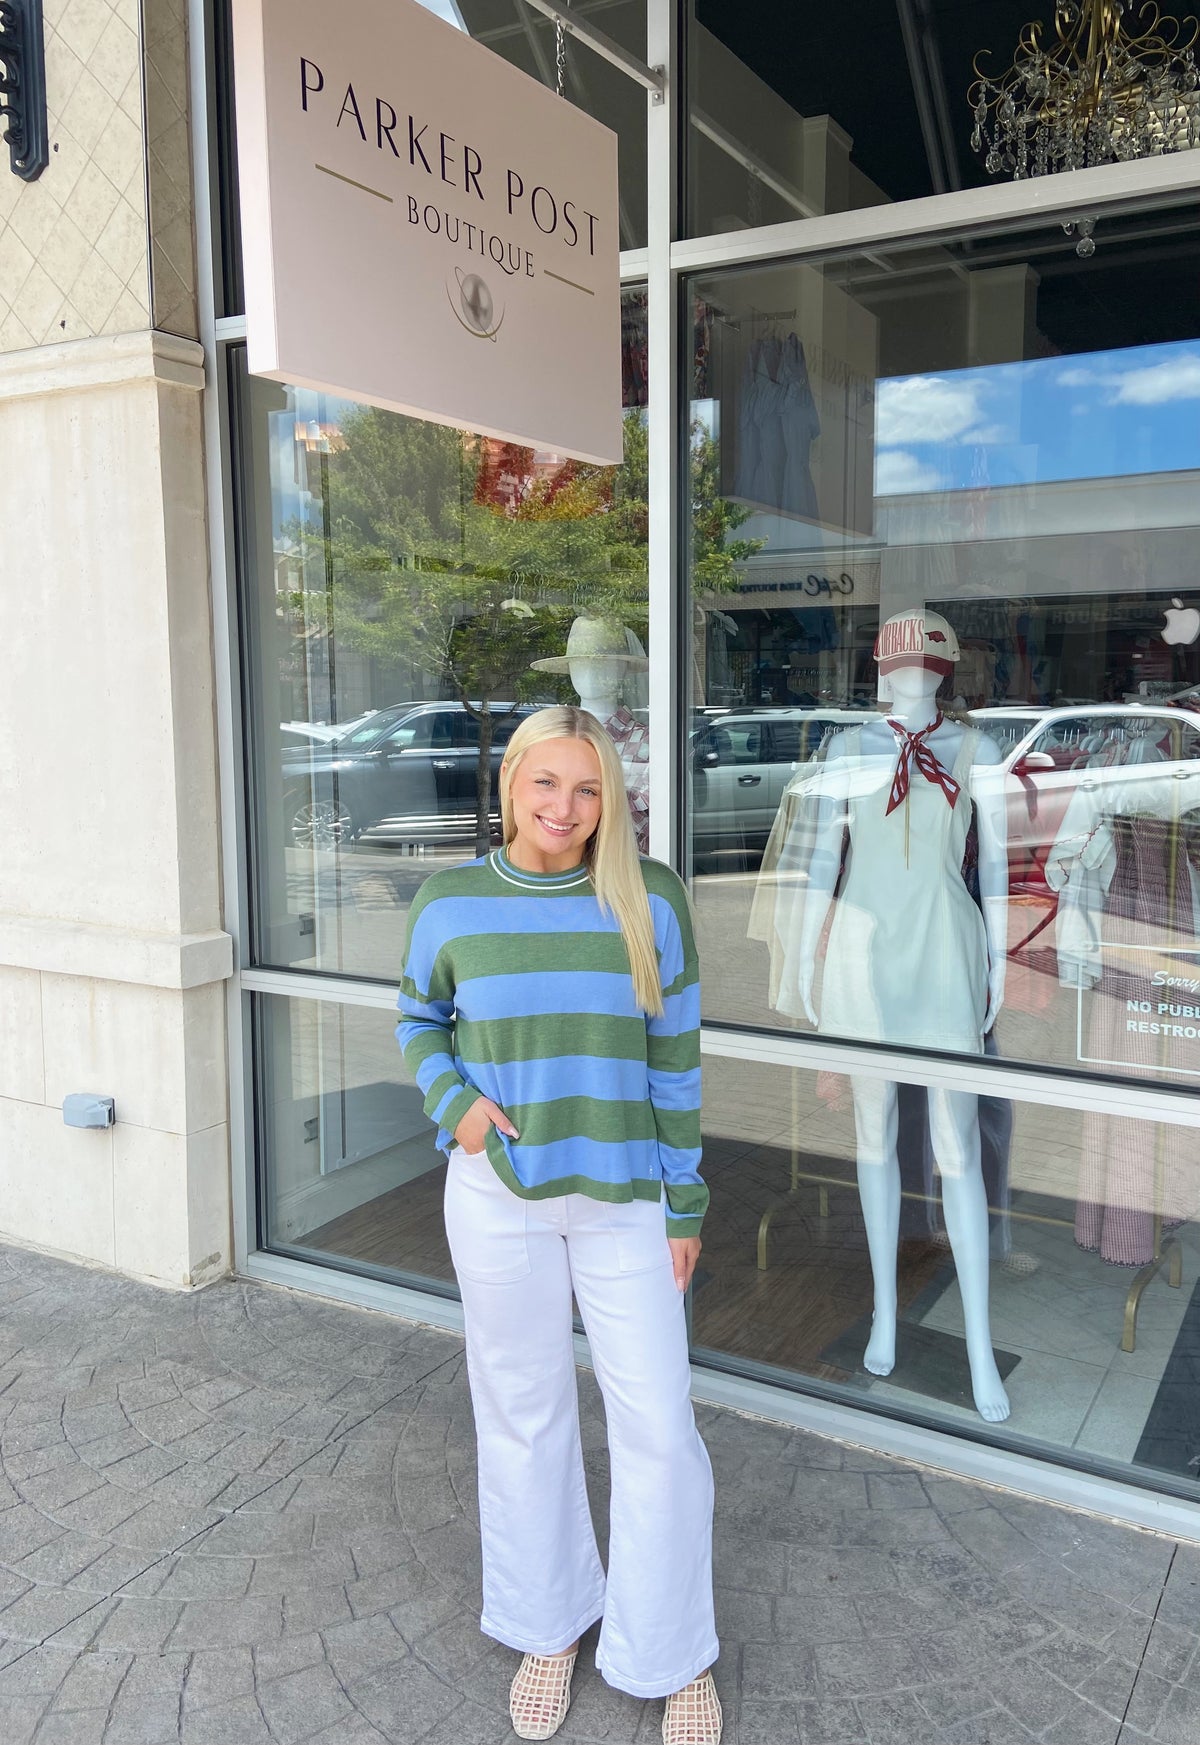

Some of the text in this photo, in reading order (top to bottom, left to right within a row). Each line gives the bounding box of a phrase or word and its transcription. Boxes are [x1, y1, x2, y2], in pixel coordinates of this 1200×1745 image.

[300, 57, 599, 256] PARKER POST
[407, 195, 535, 278] BOUTIQUE
[1151, 970, 1200, 993] Sorry
[1127, 1000, 1151, 1013] NO
[1127, 1020, 1200, 1038] RESTRO
